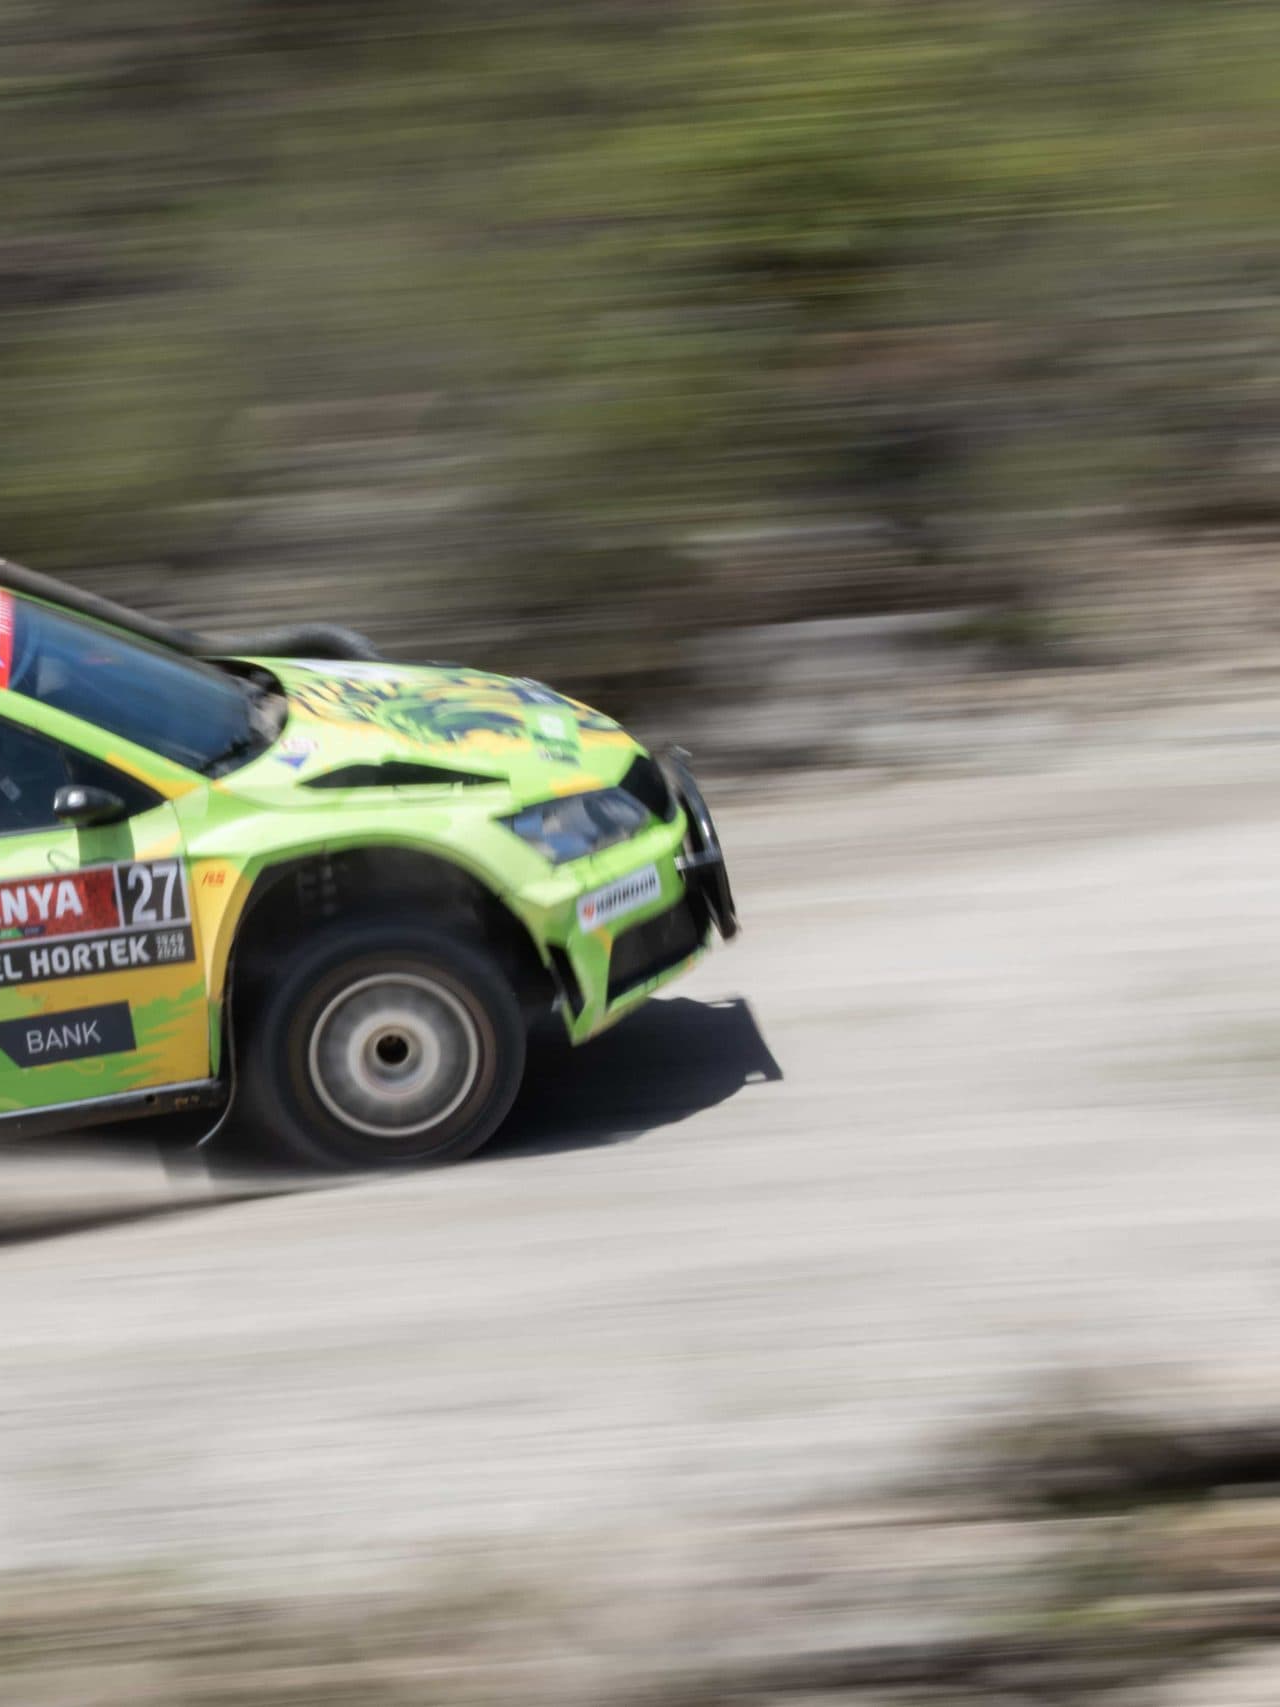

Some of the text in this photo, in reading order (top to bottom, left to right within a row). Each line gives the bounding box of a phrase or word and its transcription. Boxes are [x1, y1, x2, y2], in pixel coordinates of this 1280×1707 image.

[127, 863, 179, 924] 27
[30, 935, 150, 977] HORTEK
[26, 1020, 102, 1054] BANK
